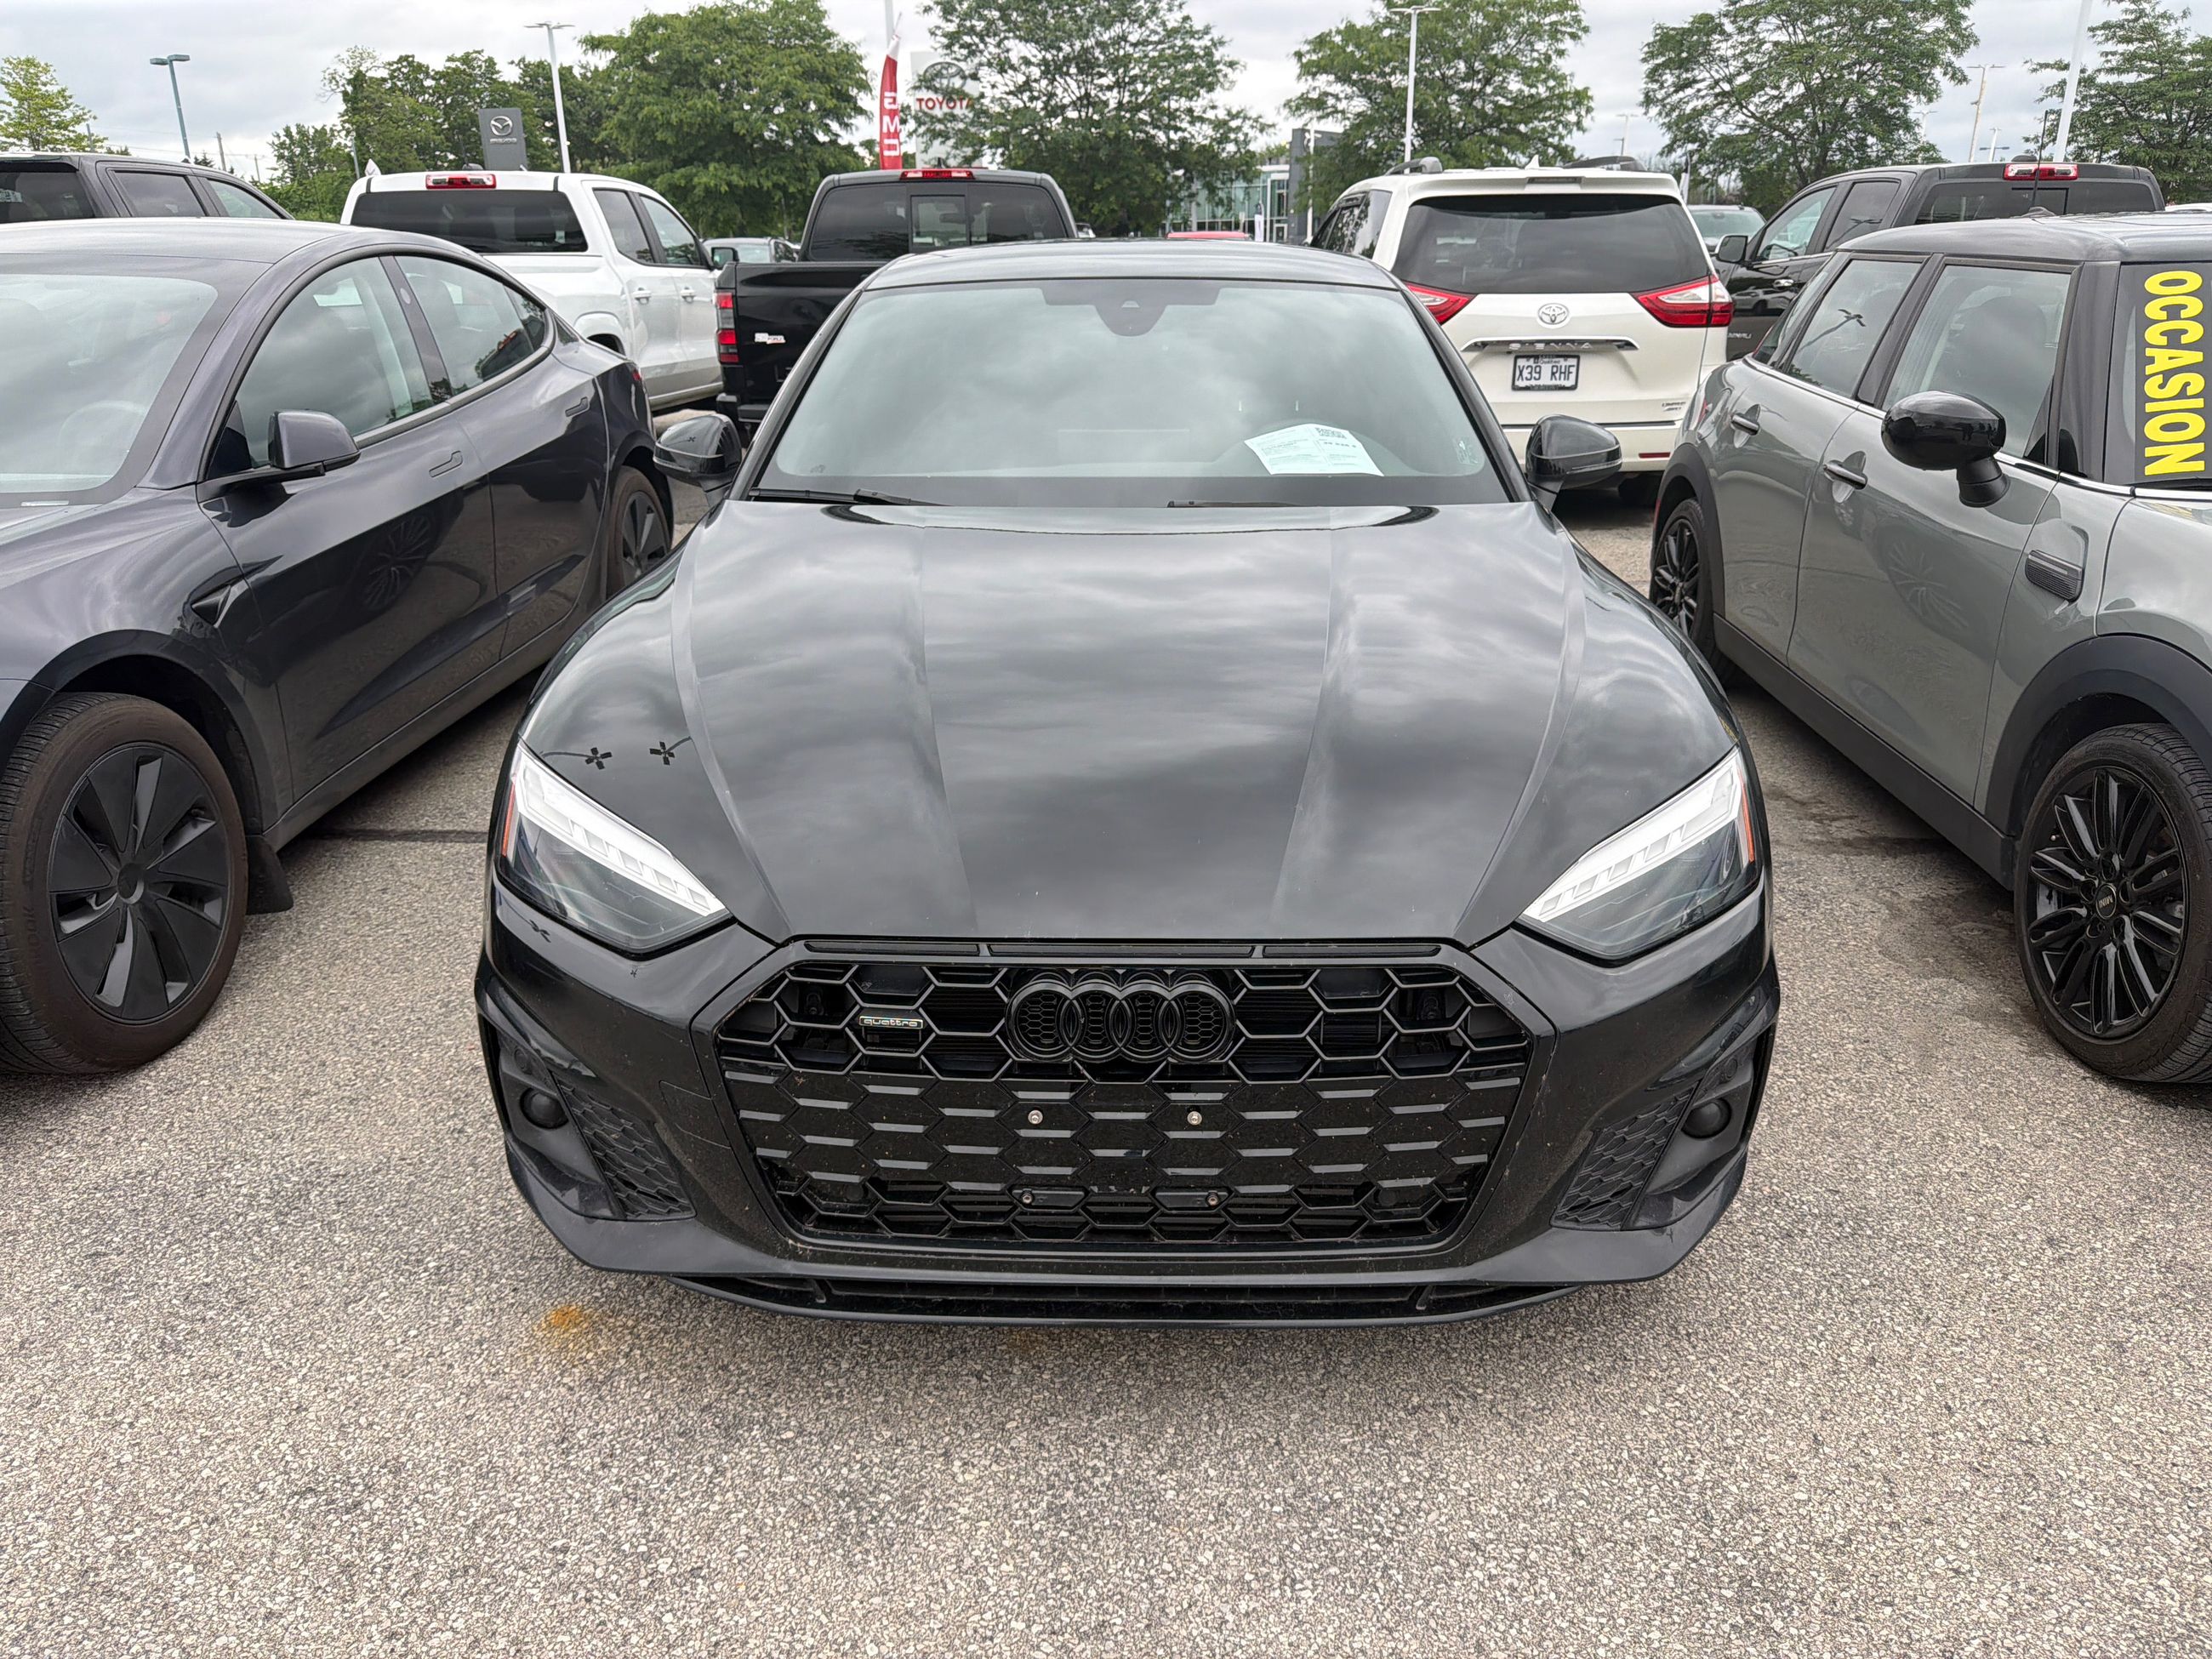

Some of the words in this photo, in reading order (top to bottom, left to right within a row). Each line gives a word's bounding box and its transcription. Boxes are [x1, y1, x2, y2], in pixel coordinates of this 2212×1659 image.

[916, 97, 973, 111] TOYOTA
[1516, 364, 1542, 382] X39
[1549, 364, 1576, 382] RHF
[2144, 271, 2206, 476] OCCASION
[2098, 894, 2114, 909] MINI
[863, 1018, 918, 1028] quattro
